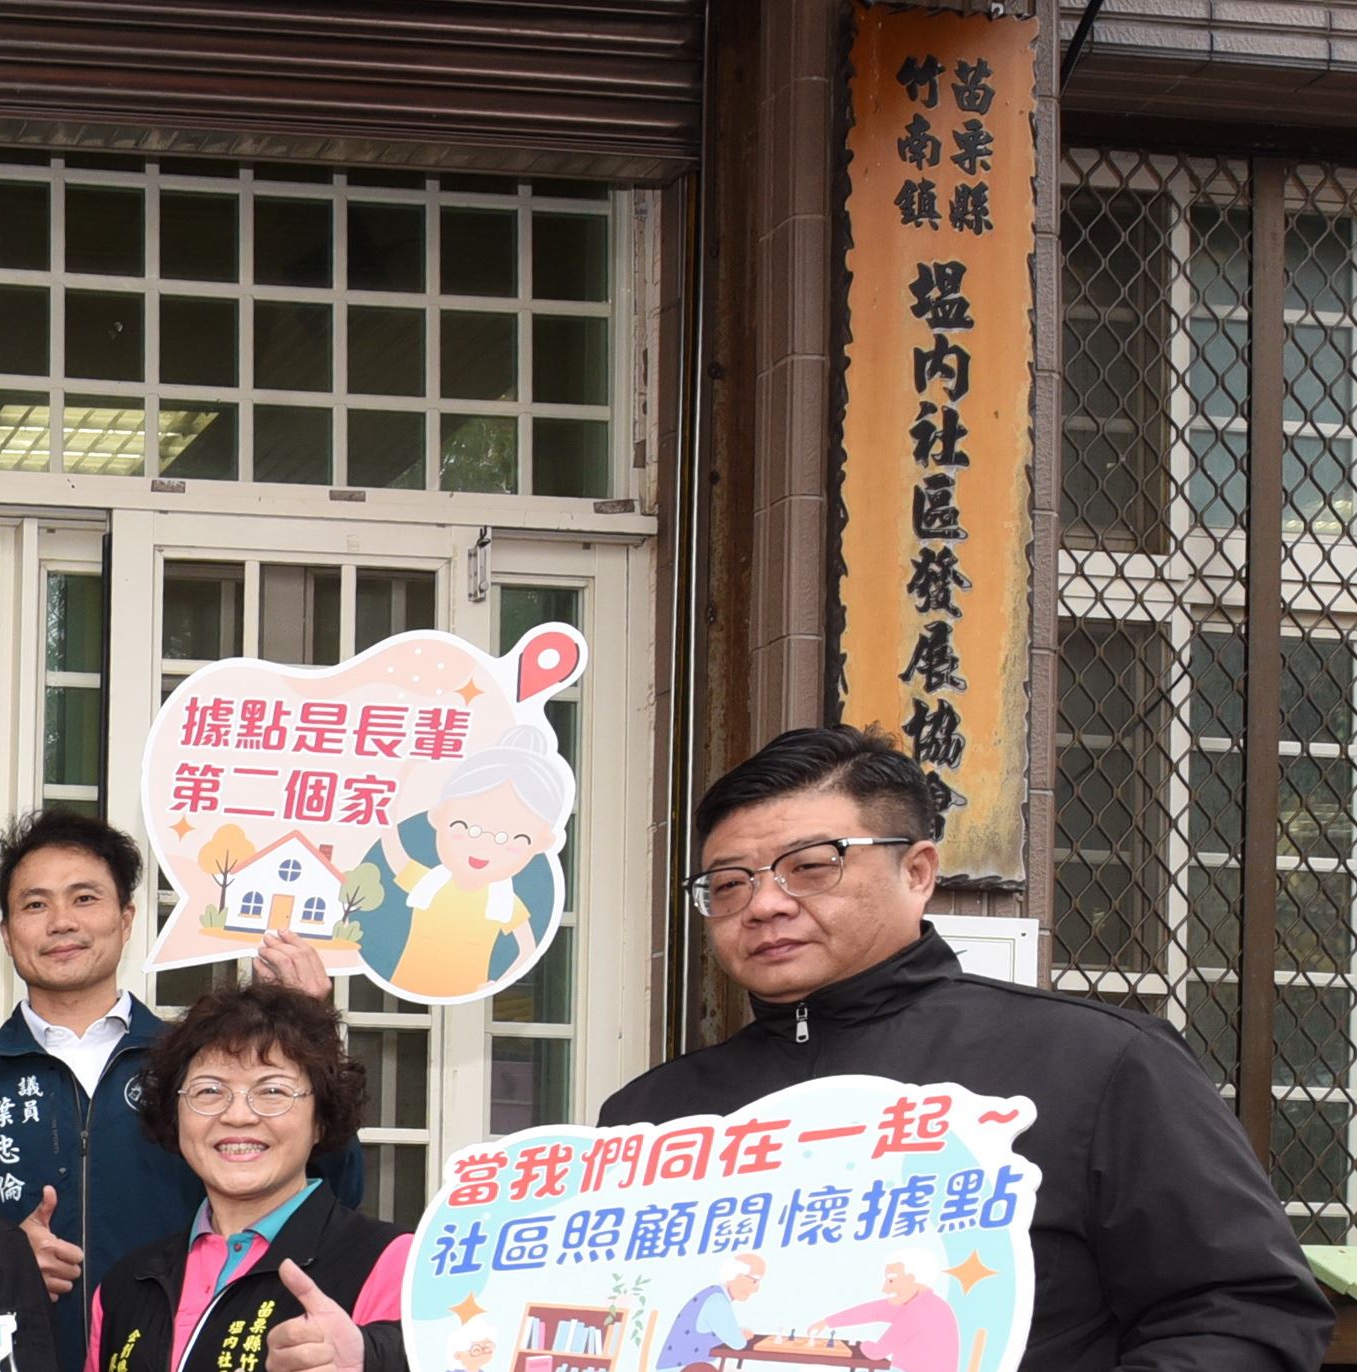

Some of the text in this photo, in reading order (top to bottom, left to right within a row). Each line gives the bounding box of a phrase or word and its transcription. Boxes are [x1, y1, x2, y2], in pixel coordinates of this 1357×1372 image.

[893, 54, 946, 232] 竹南鎮
[948, 57, 994, 236] 苗栗縣
[179, 696, 473, 761] 據點是長輩
[168, 762, 398, 827] 第二個家
[17, 1075, 45, 1124] 議員
[430, 1163, 1025, 1277] 社區照顧關懷據點
